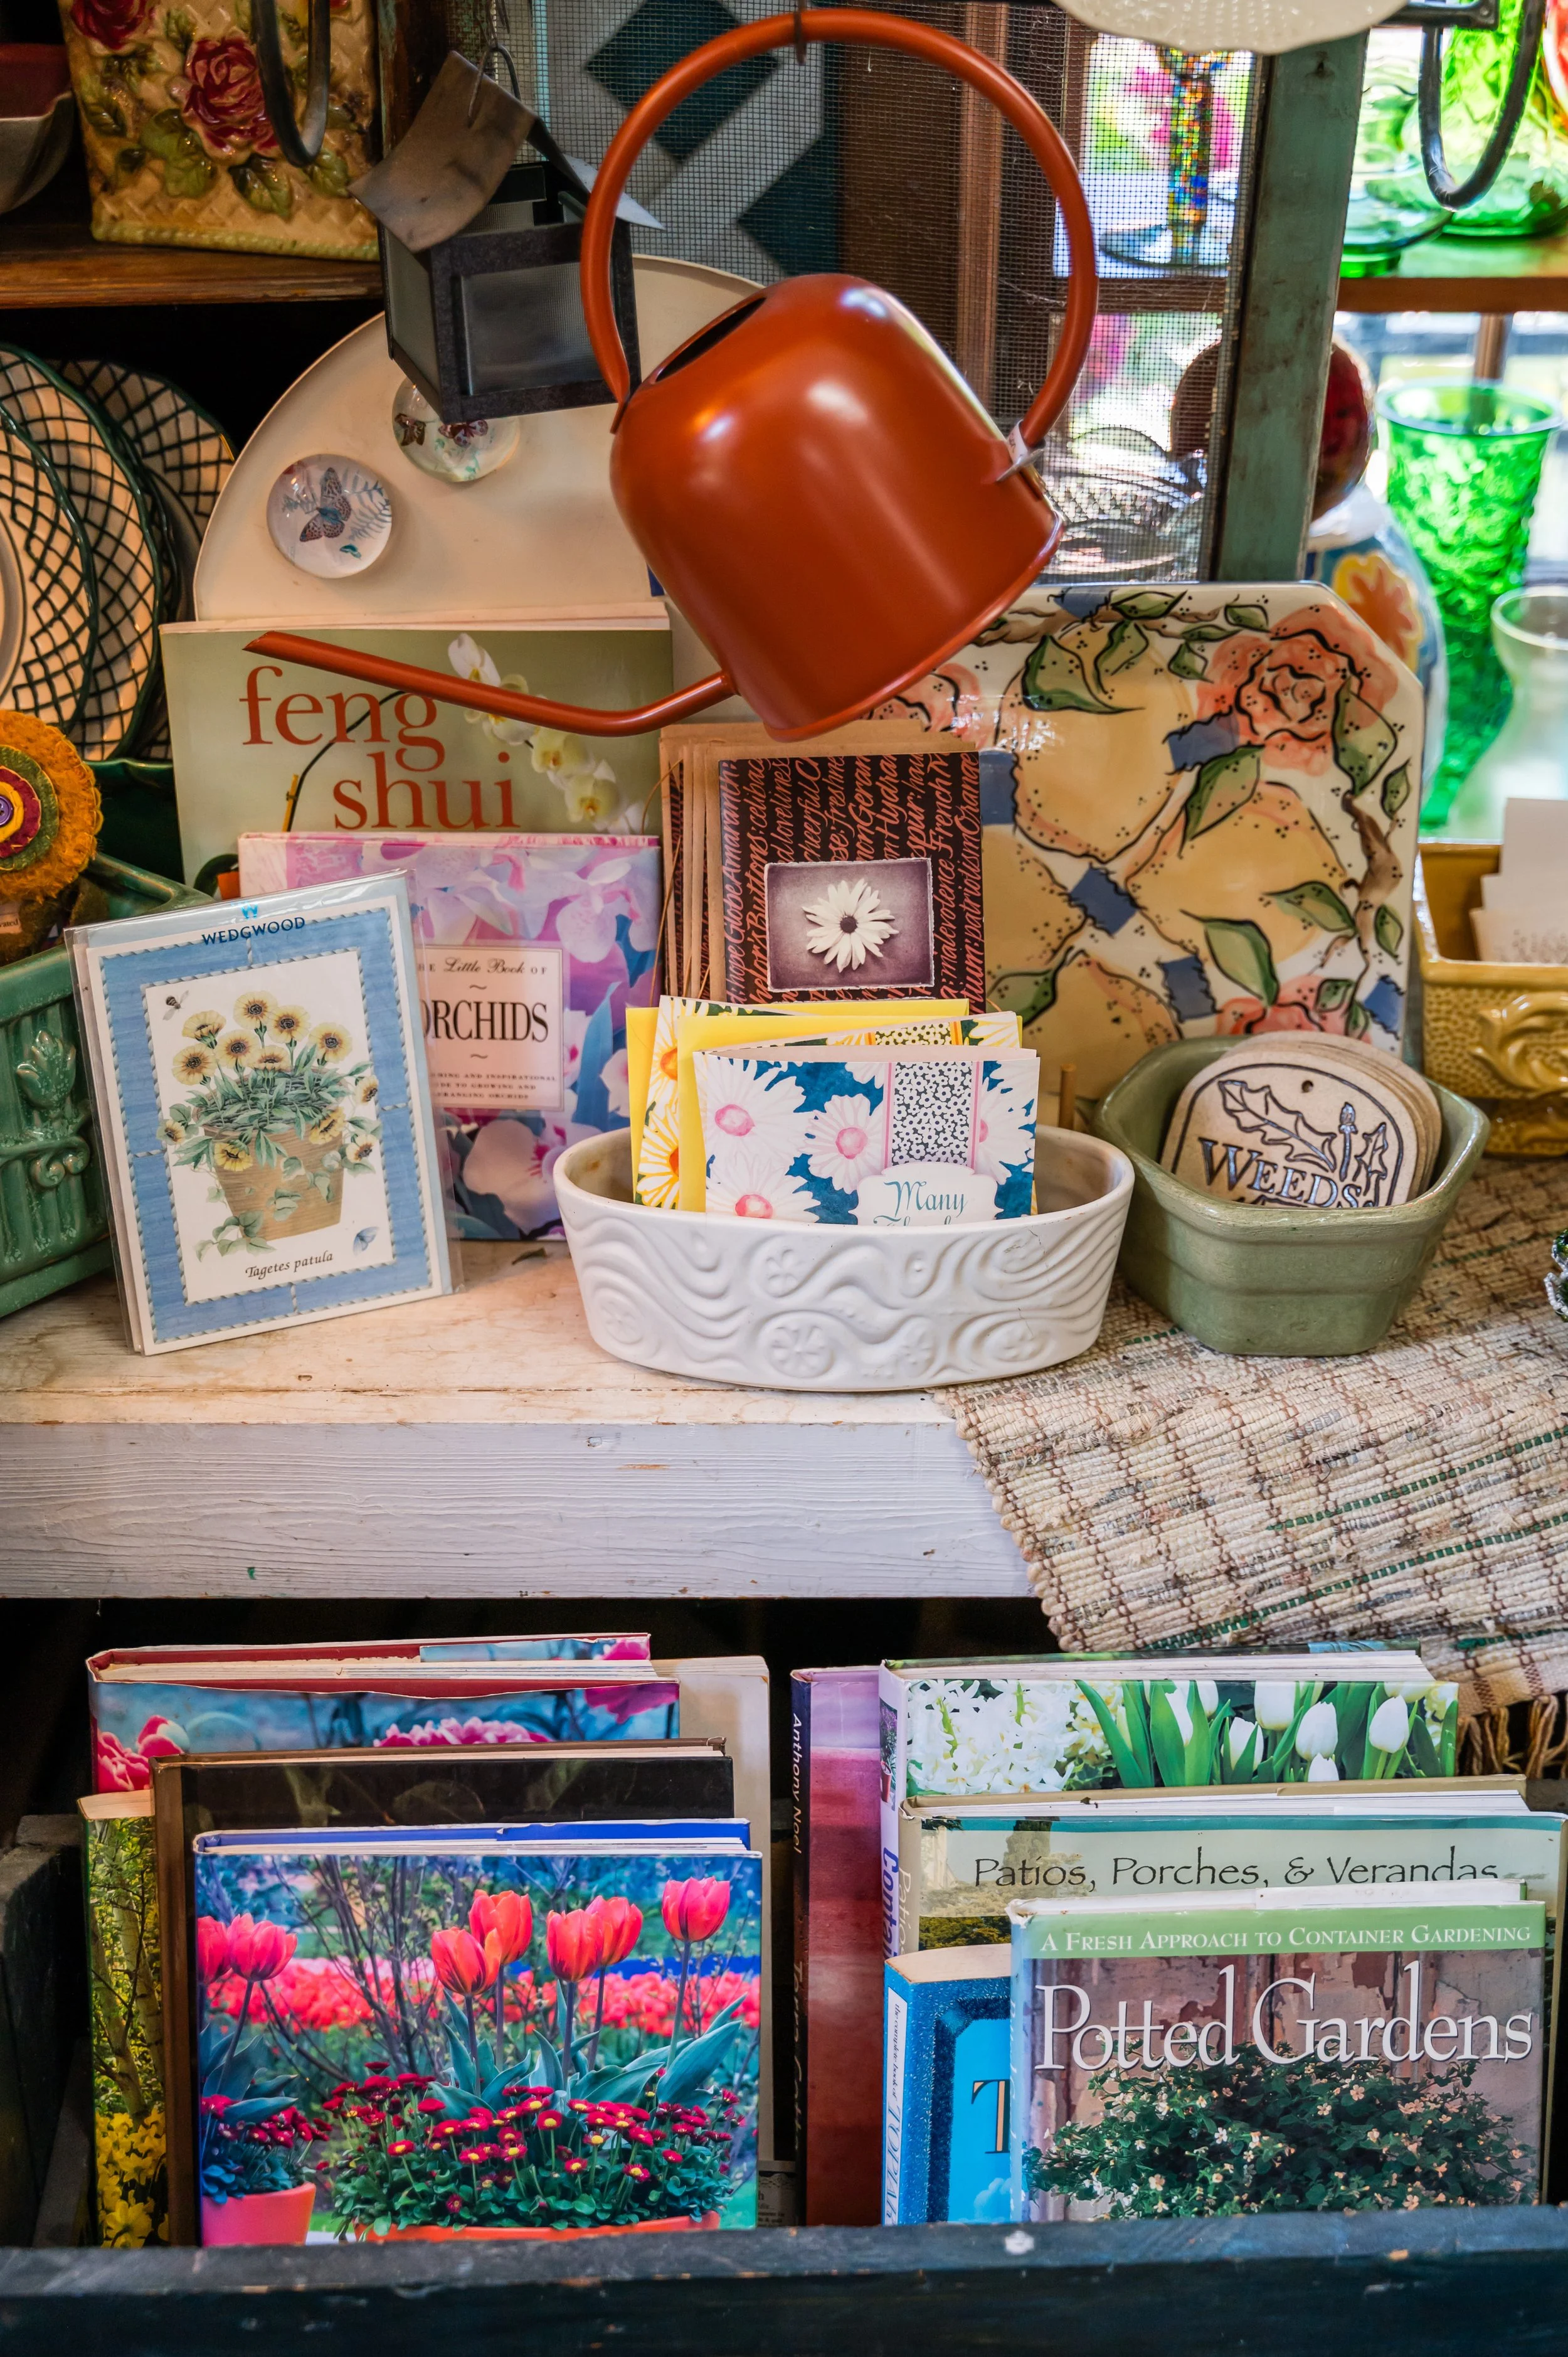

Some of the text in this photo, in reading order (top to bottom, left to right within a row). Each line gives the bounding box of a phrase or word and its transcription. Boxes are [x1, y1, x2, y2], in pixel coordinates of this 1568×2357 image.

[239, 666, 446, 772] feng
[332, 750, 522, 831] shui
[201, 917, 305, 945] WEDGWOOD
[443, 956, 481, 973] Little
[487, 957, 525, 974] Book
[746, 931, 771, 1004] helor's
[884, 1181, 968, 1218] Many
[1198, 1137, 1362, 1208] WEEDS
[245, 1250, 334, 1280] Tagetes patula
[790, 1712, 803, 1802] Anthony
[792, 1806, 803, 1854] Noel
[883, 1847, 899, 1959] Contai
[974, 1846, 1500, 1892] Patios, Porches, & Verandas
[1041, 1923, 1531, 1951] A FRESH APPROACH TO CONTAINER GARDENING
[1034, 1959, 1534, 2072] Potted Gardens
[886, 2102, 902, 2225] TOPIAR
